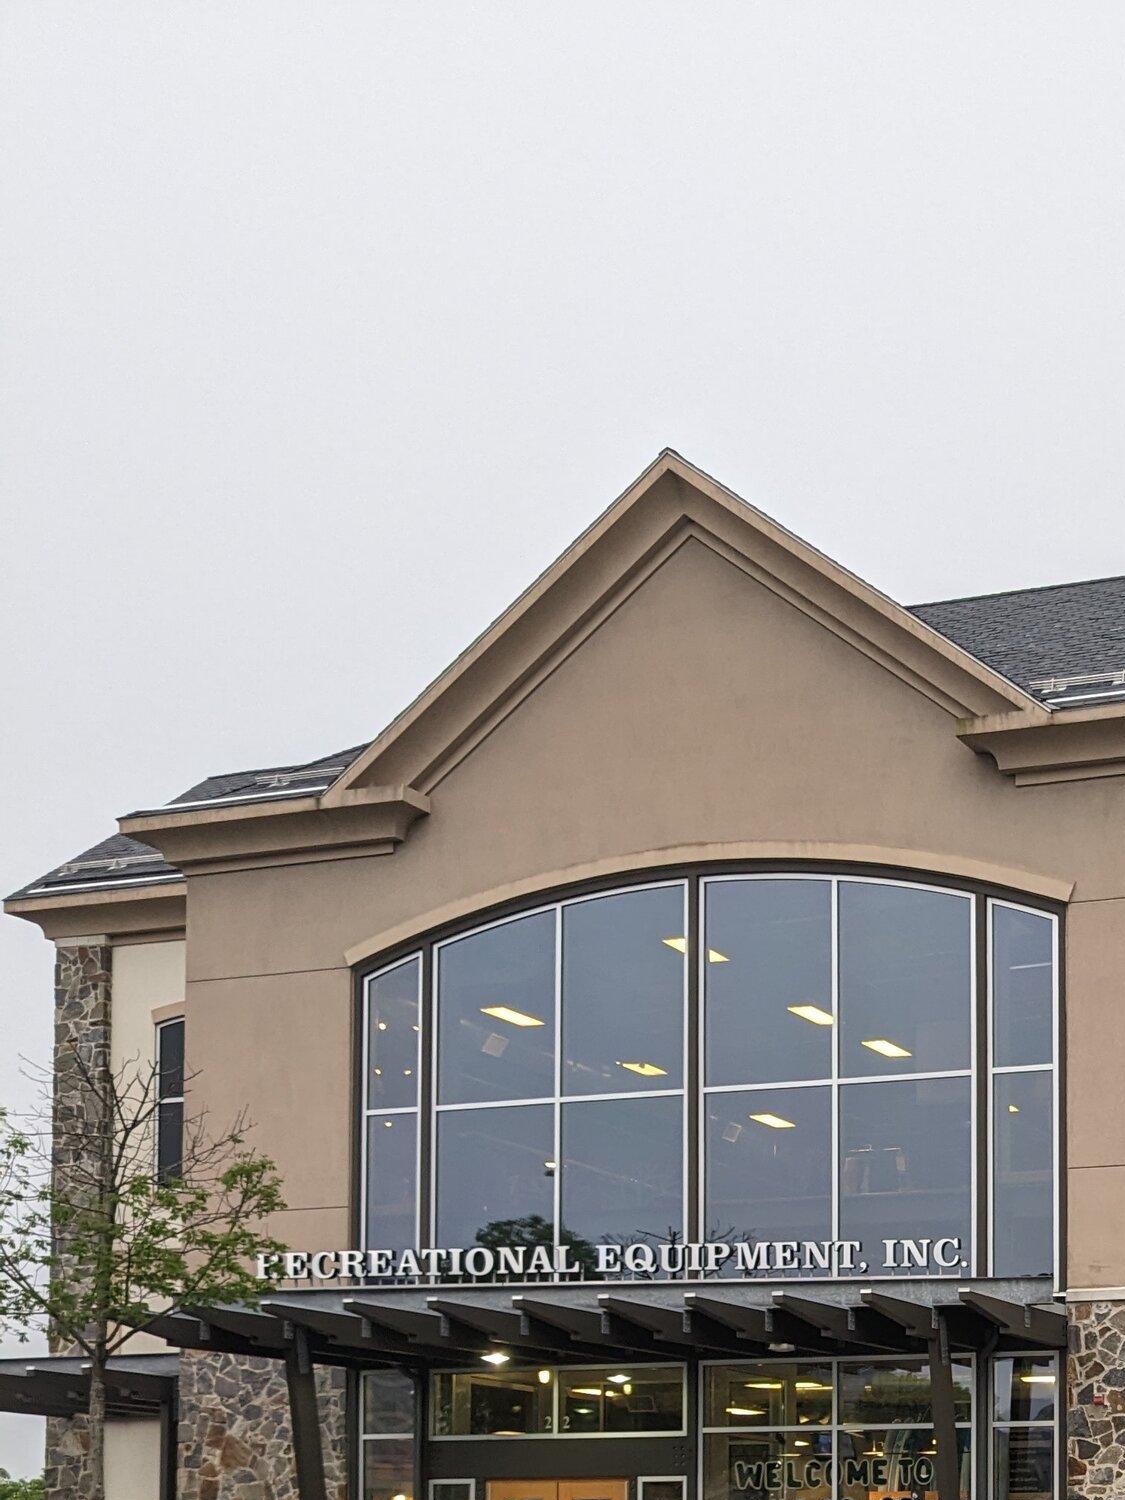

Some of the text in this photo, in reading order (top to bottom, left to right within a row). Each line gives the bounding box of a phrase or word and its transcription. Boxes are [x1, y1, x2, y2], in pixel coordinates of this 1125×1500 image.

[255, 1237, 969, 1280] RECREATIONAL EQUIPMENT, INC.
[735, 1457, 934, 1490] WELCOME TO
